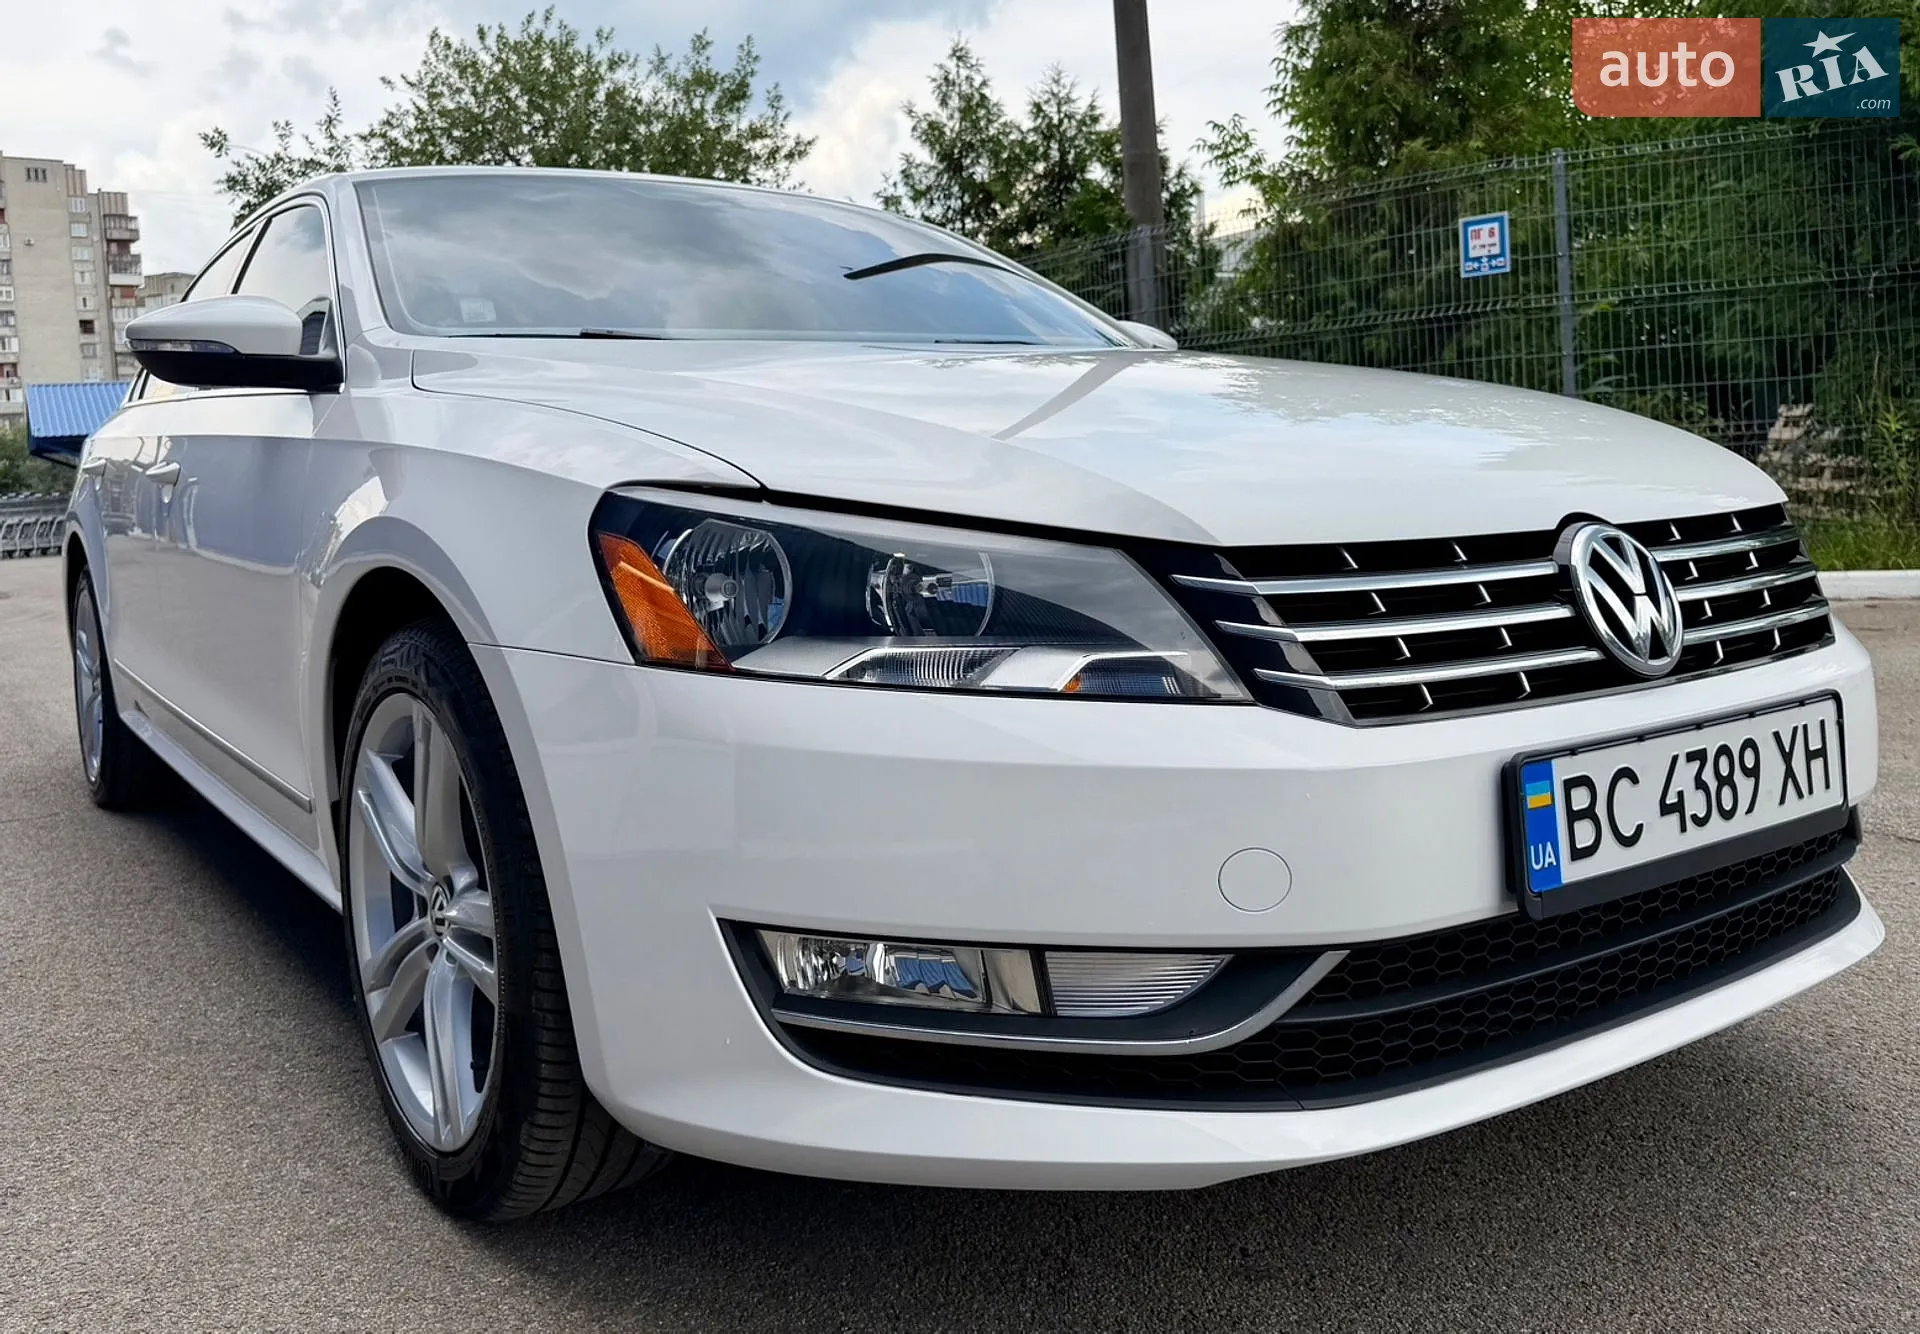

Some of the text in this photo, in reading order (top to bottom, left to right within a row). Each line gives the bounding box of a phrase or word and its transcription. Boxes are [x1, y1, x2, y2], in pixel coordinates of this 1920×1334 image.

[1563, 718, 1831, 862] BC 4389 XH
[1530, 843, 1557, 871] UA
